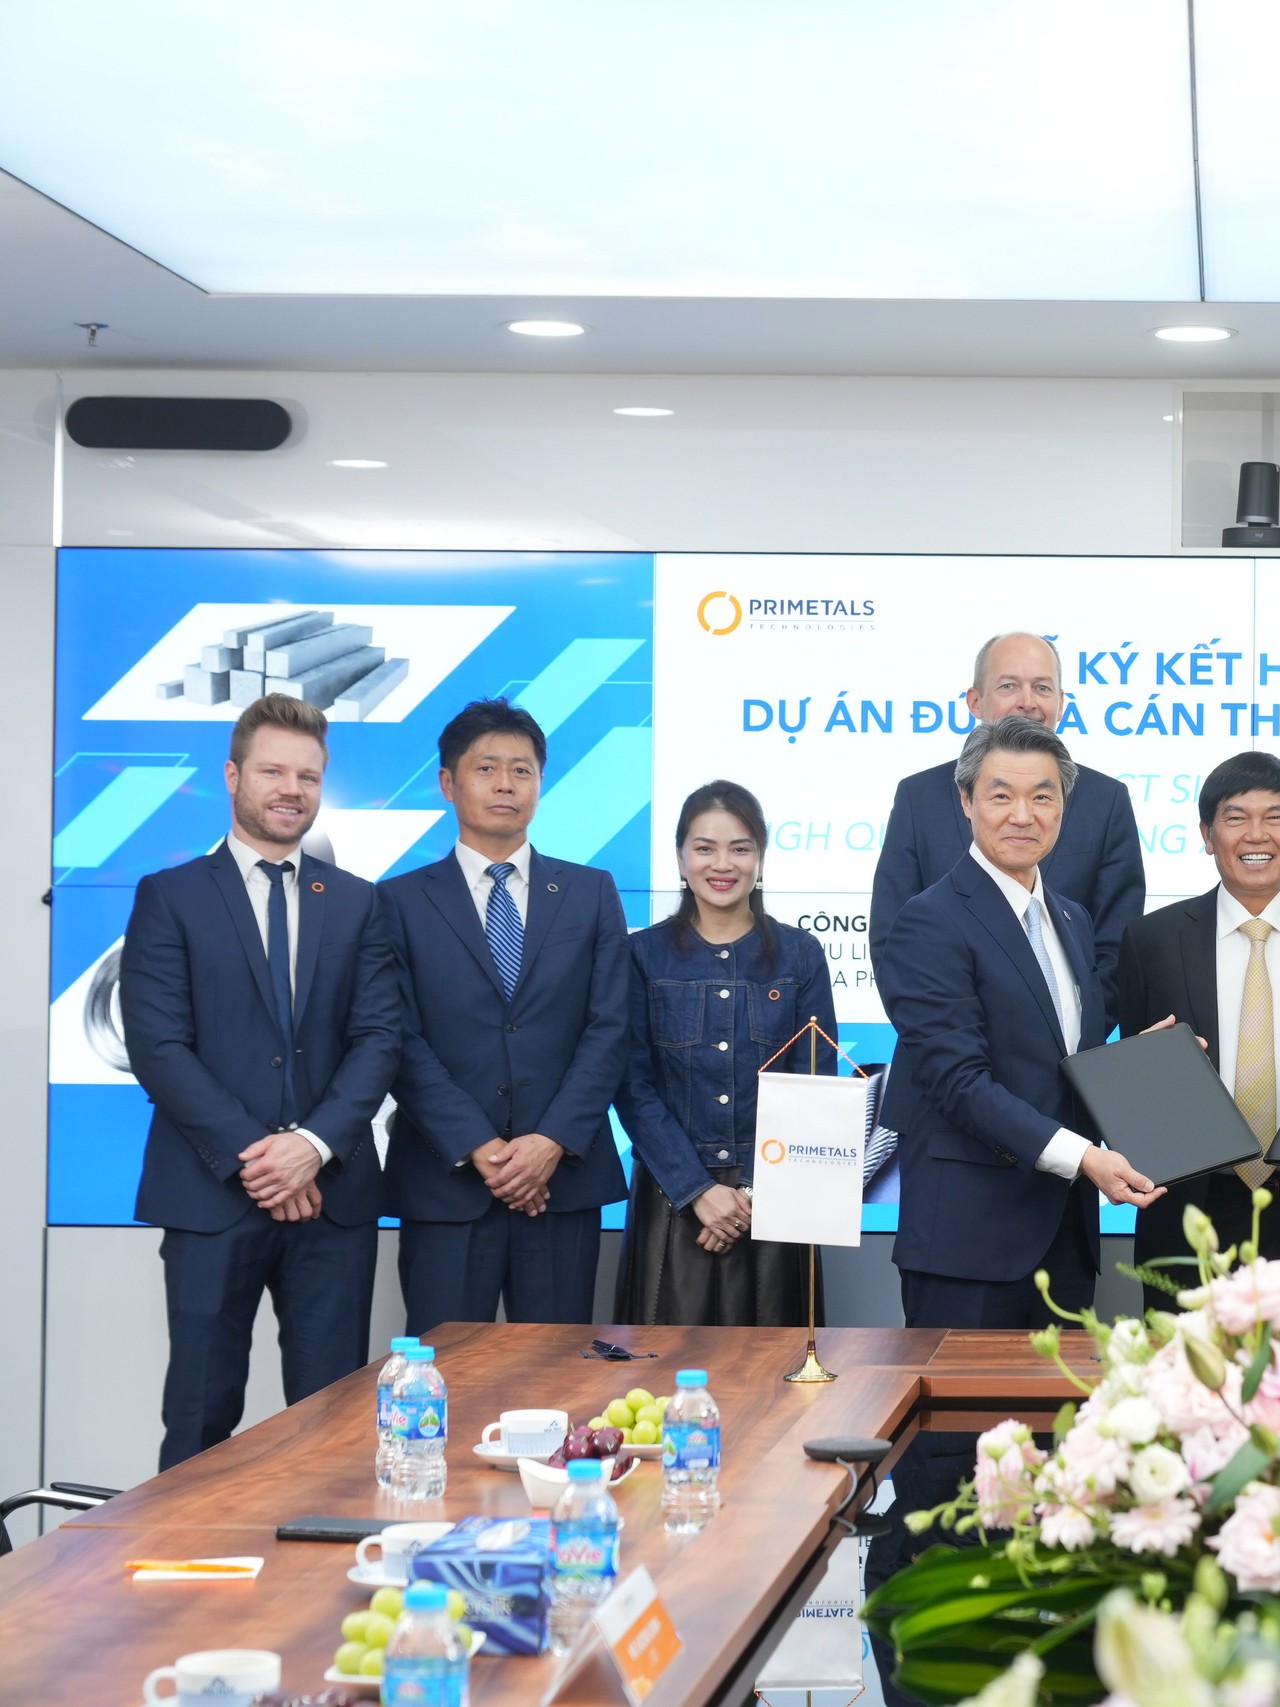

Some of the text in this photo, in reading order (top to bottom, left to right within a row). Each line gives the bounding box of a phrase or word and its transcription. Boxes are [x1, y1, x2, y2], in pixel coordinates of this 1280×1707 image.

[749, 599, 875, 616] PRIMETALS
[749, 623, 876, 632] TECHNOLOGIES
[1078, 641, 1140, 685] KÝ
[1155, 638, 1243, 686] KẾT
[742, 696, 812, 744] DỰ
[824, 690, 893, 733] ÁN
[910, 692, 976, 735] ĐÚ
[1056, 692, 1088, 735] À
[1103, 693, 1205, 736] CÁN
[797, 910, 868, 933] CÔNG
[788, 1144, 858, 1158] PRIMETALS
[788, 1157, 858, 1166] TECHNOLOGIES
